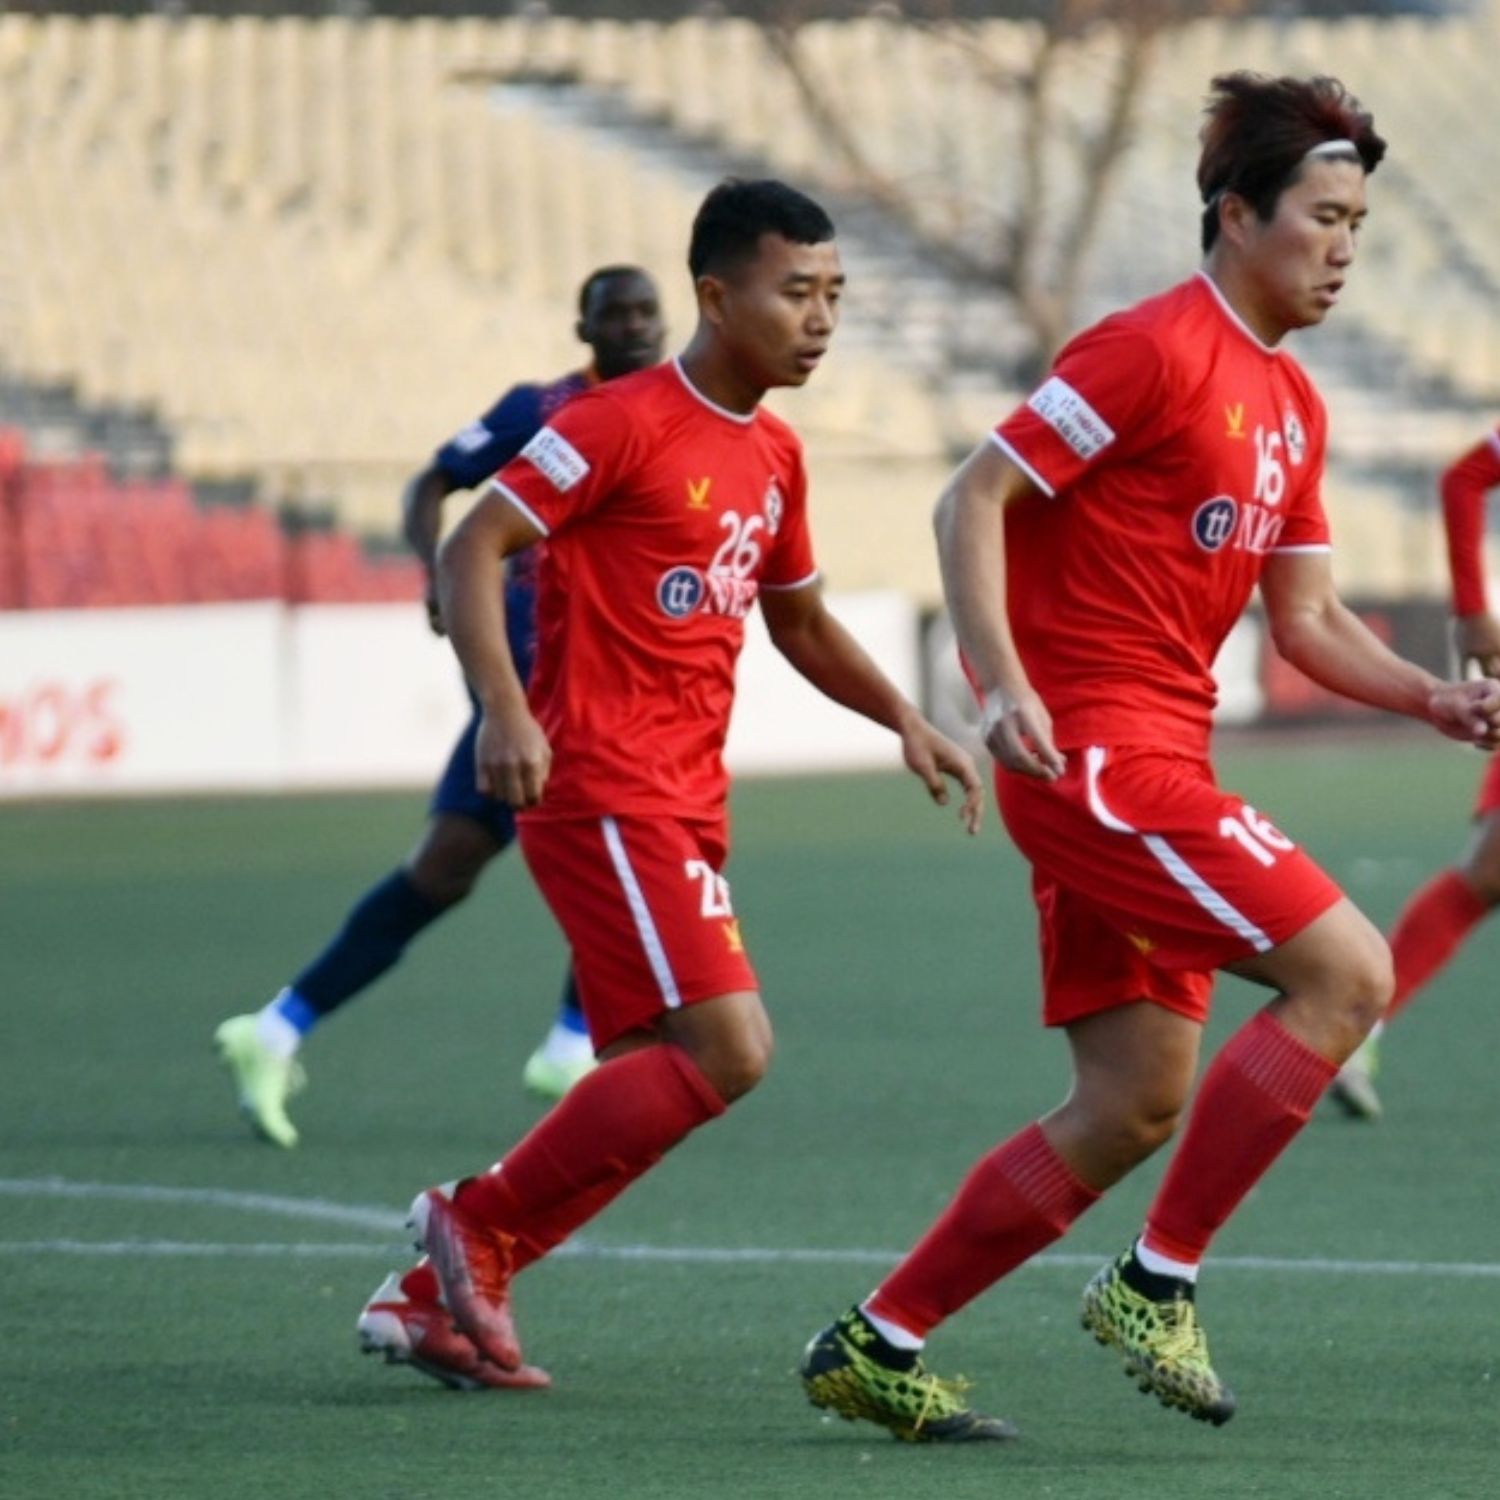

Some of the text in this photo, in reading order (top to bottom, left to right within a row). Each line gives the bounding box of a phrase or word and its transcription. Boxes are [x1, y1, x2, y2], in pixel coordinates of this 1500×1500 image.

[1254, 425, 1286, 506] 16
[706, 509, 764, 579] 26
[1218, 803, 1296, 869] 16
